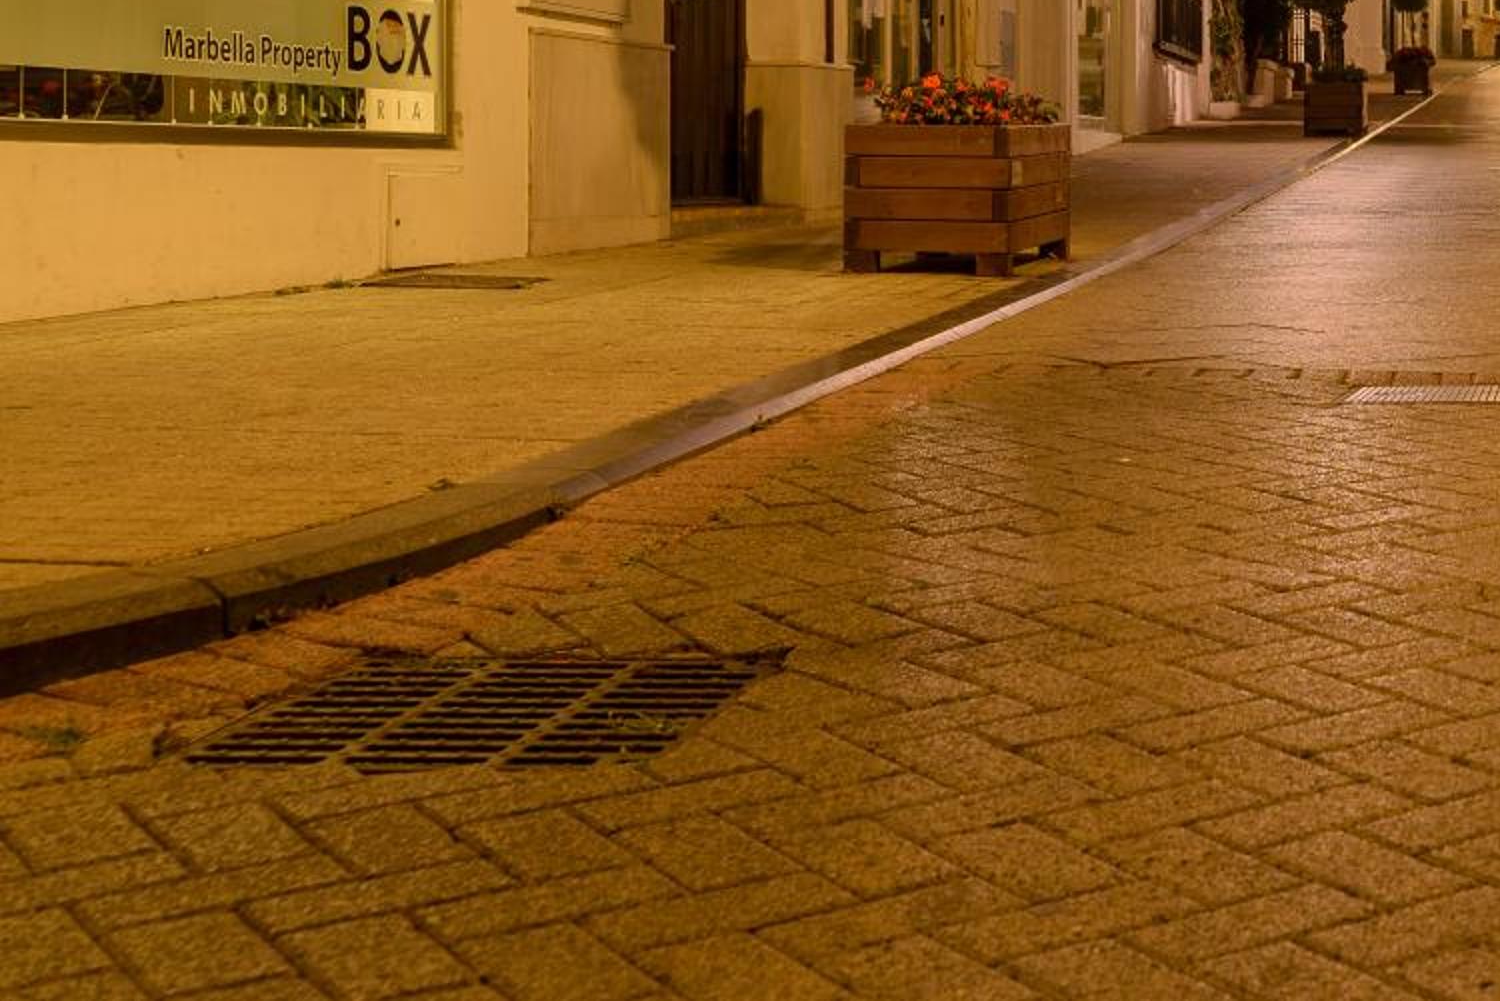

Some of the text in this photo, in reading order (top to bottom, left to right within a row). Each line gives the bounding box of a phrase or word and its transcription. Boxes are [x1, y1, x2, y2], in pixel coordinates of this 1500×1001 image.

[163, 5, 432, 78] Marbella Property BOX
[188, 87, 423, 121] INMOBILIARIA
